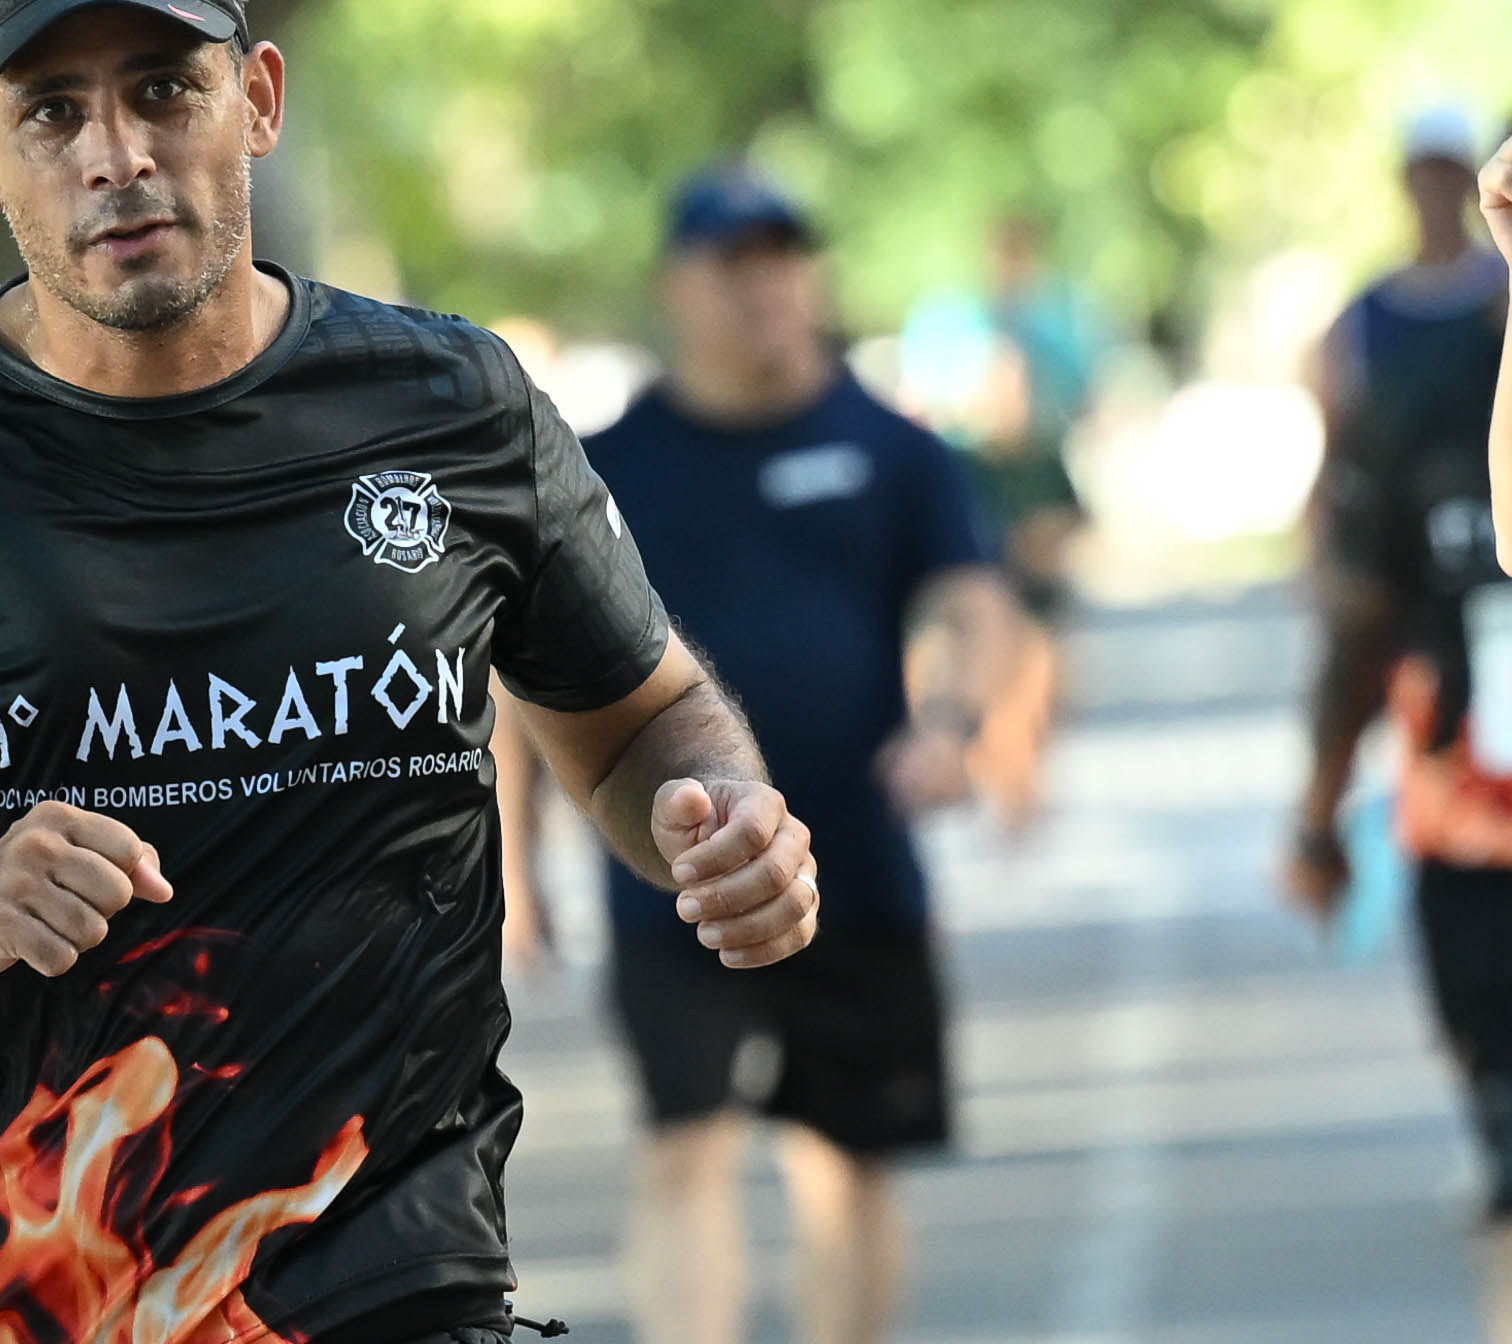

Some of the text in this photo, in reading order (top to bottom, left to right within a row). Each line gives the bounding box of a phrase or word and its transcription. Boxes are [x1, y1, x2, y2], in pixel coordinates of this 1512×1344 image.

[380, 496, 422, 532] 27
[76, 623, 465, 762] MARATÓN
[94, 779, 232, 807] BOMBEROS
[240, 757, 401, 797] VOLUNTARIOS
[409, 748, 482, 777] ROSARIO
